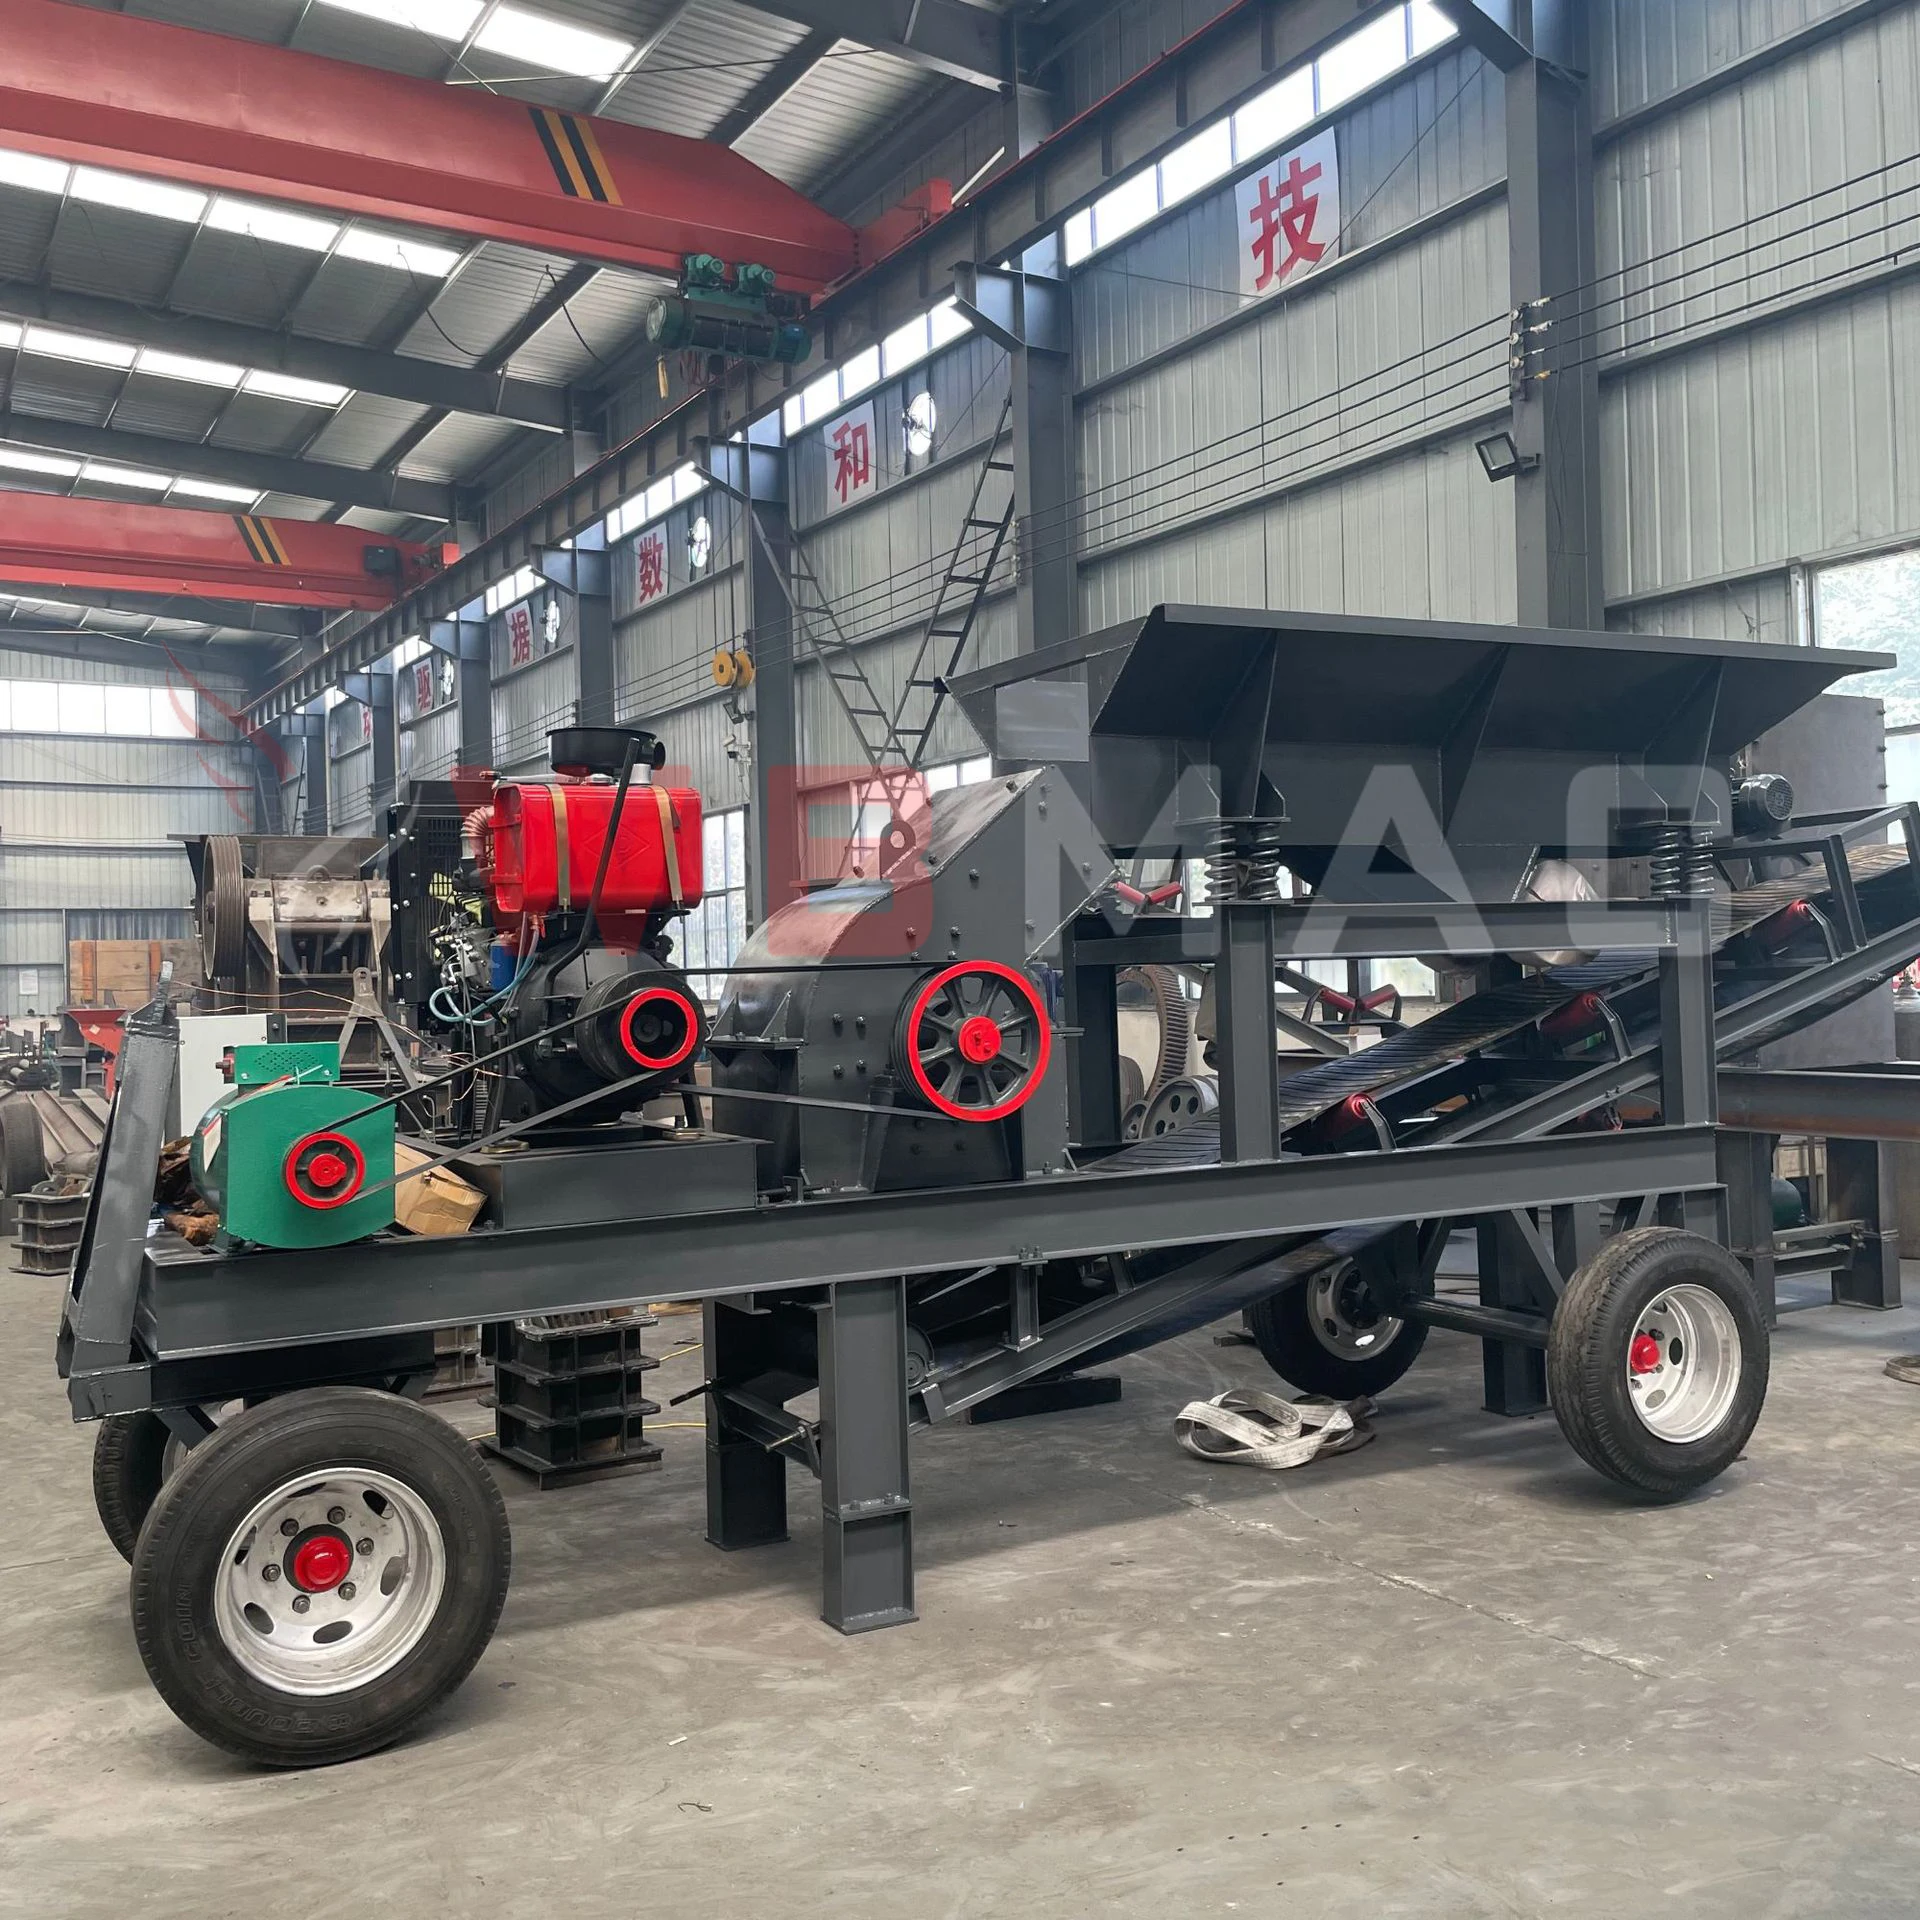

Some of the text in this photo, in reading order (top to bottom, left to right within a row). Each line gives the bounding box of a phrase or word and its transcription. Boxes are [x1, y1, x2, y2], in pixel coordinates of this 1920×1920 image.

[1250, 157, 1325, 291] 技
[832, 421, 868, 503] 和
[639, 532, 663, 603] 数
[511, 609, 530, 666] 据
[416, 665, 431, 710] 驱
